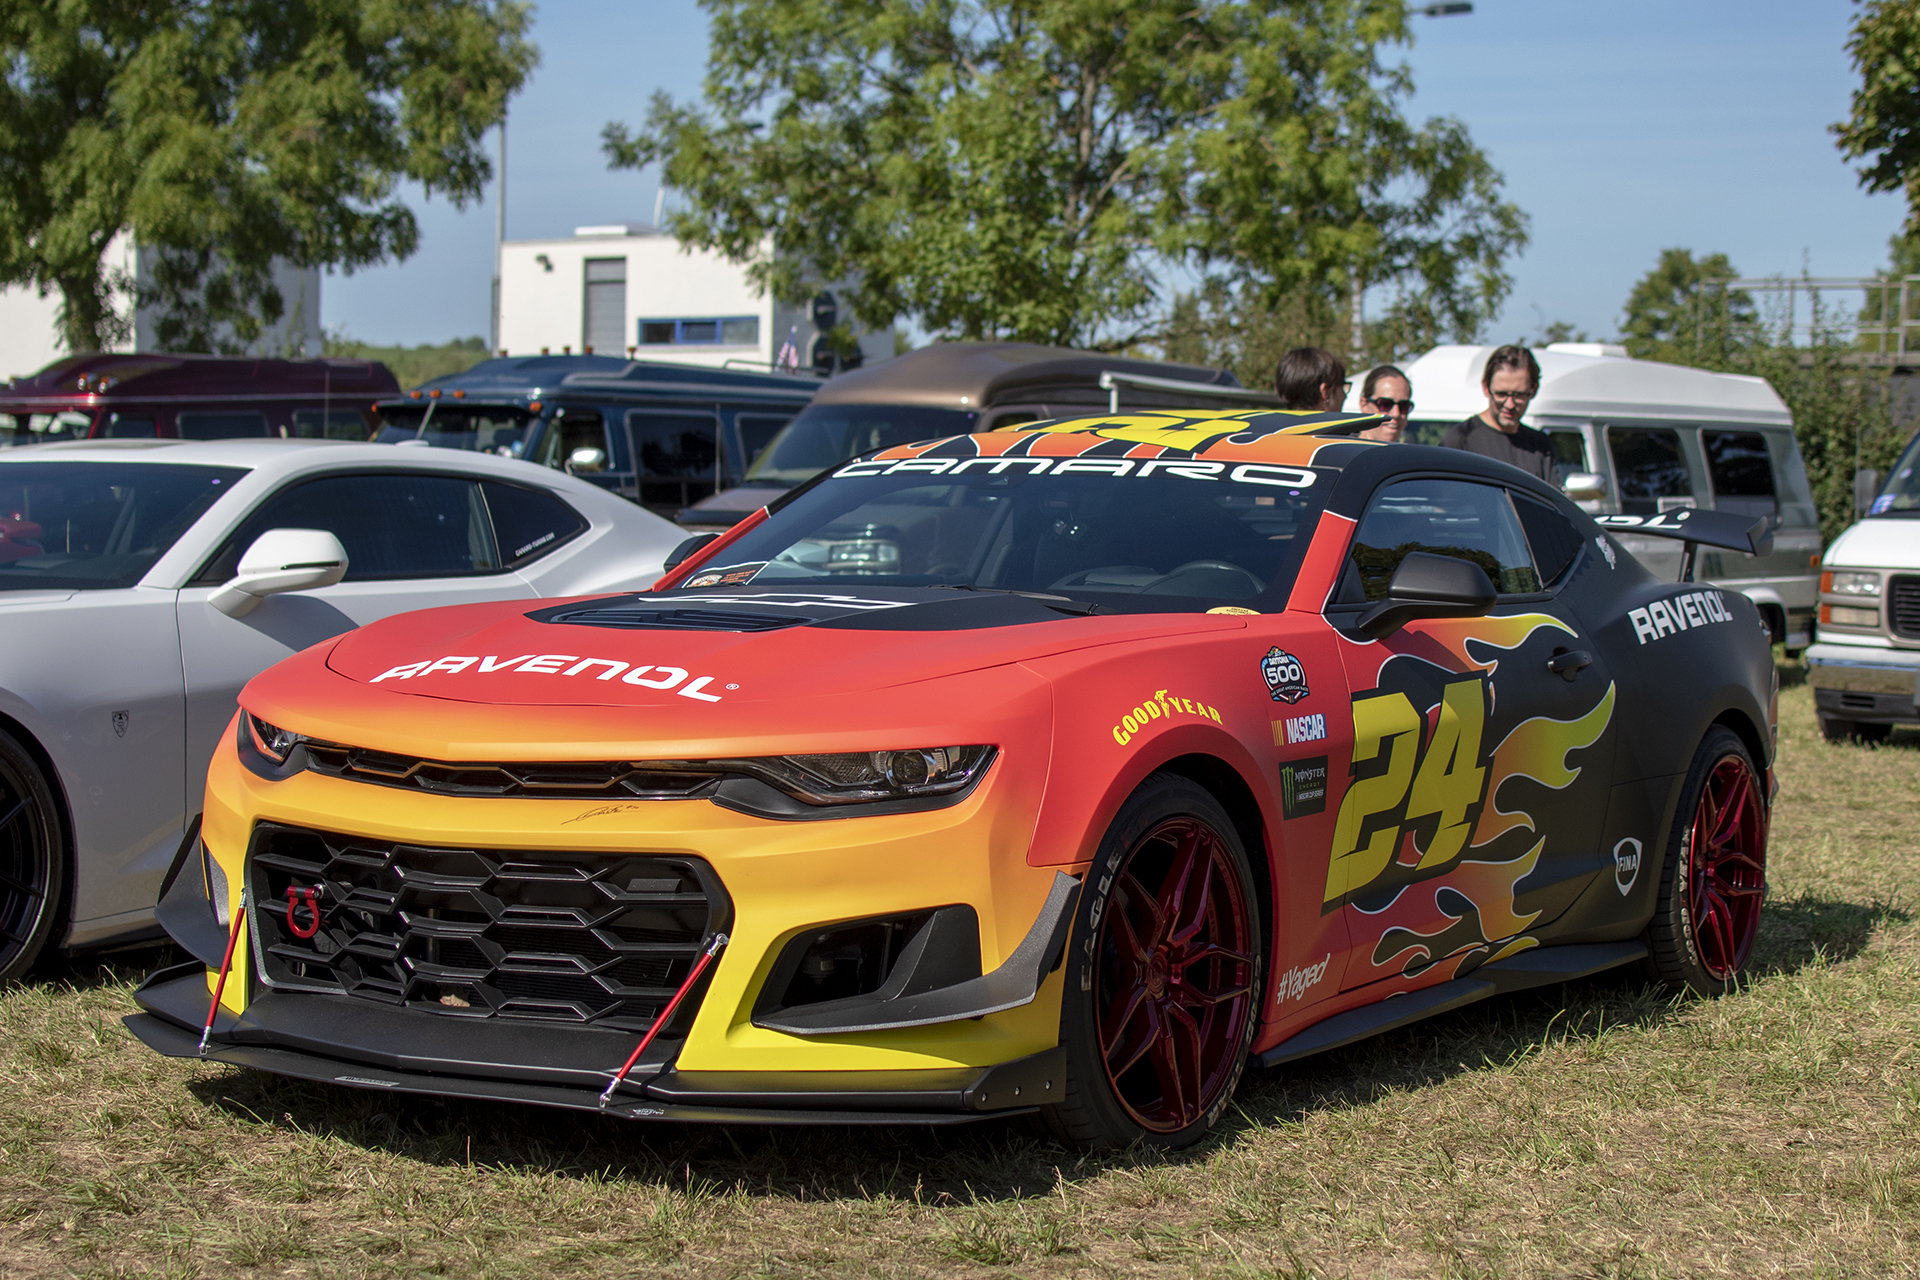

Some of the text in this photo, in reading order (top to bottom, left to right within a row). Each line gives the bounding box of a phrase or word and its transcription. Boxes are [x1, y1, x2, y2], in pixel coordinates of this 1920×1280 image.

[832, 458, 1317, 488] CAMARO
[1627, 591, 1733, 645] RAVENOL
[1268, 656, 1290, 665] DAYTONA
[1266, 664, 1301, 684] 500
[1286, 713, 1326, 744] NASCAR
[1294, 767, 1326, 782] MONSTER
[1299, 781, 1320, 789] ENERGY
[1323, 679, 1485, 903] 24
[1617, 854, 1638, 873] FINA
[1081, 847, 1122, 992] EAGLE
